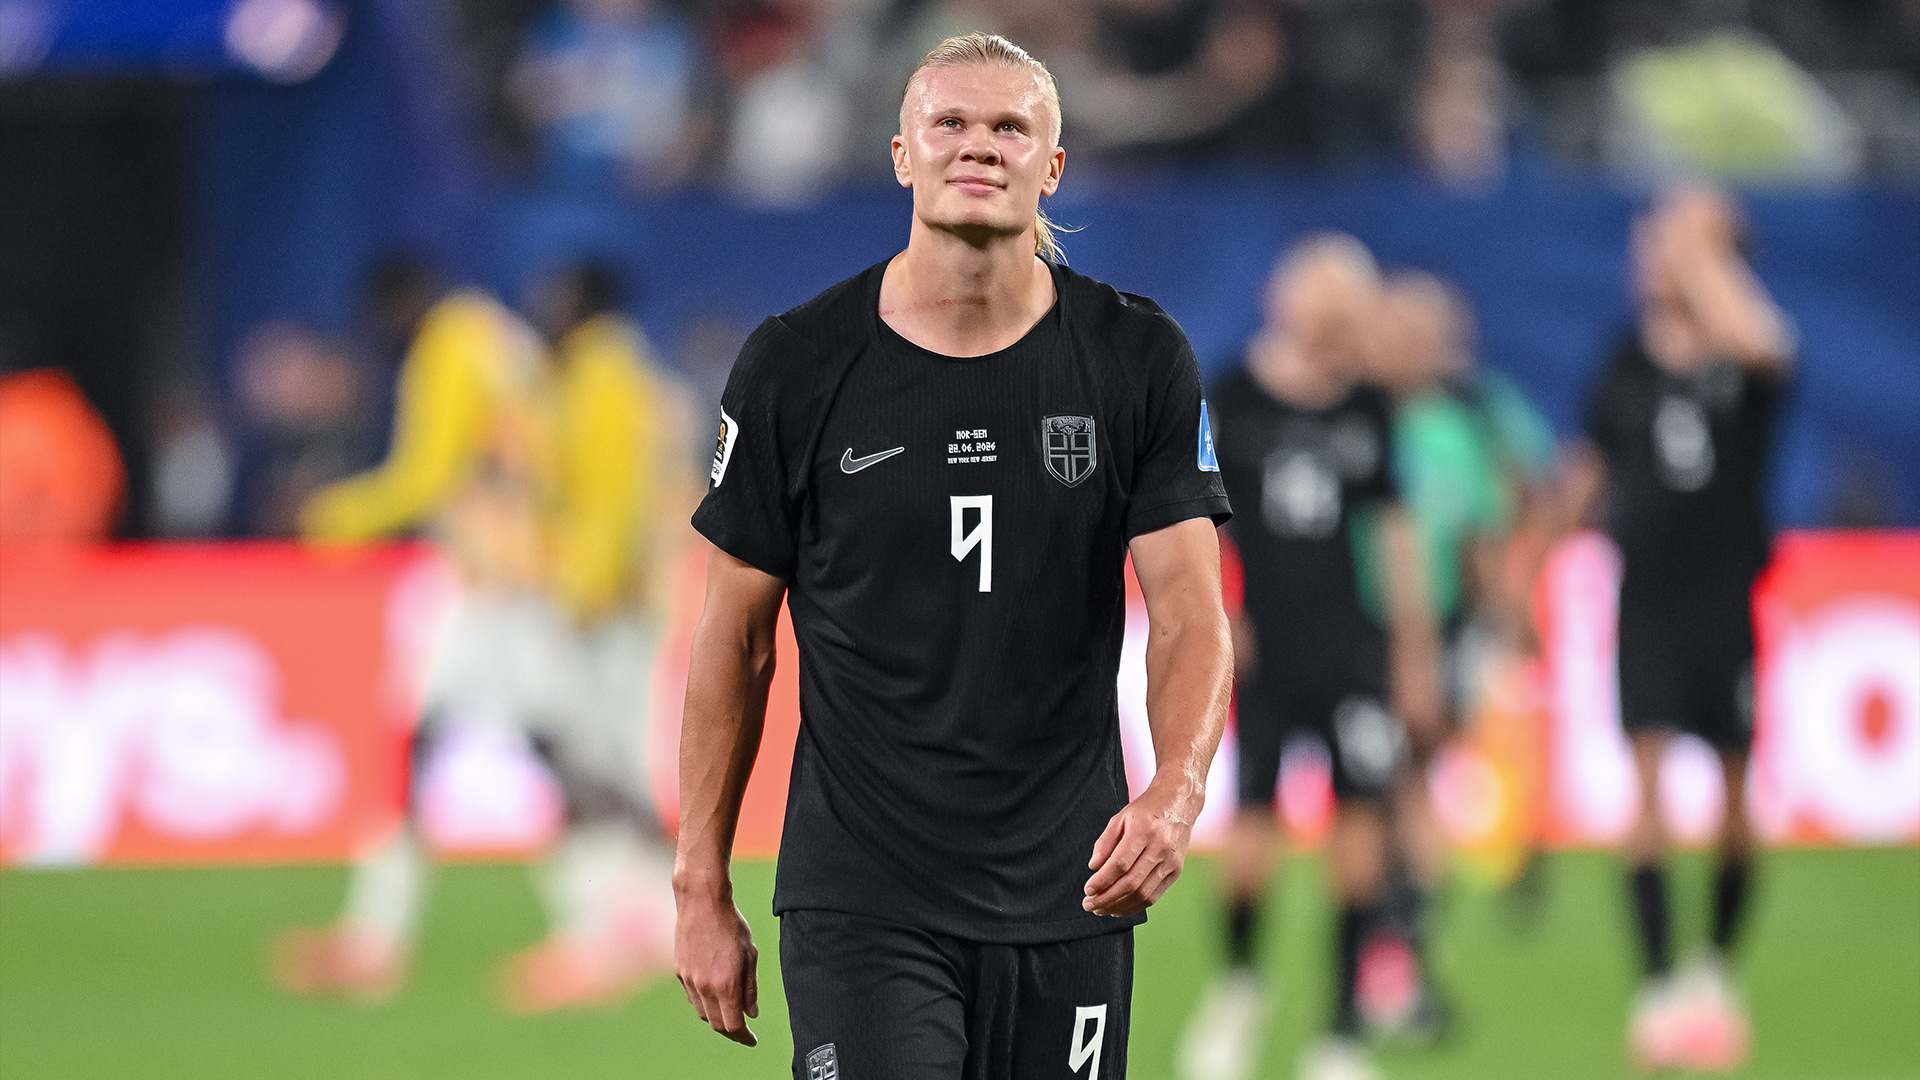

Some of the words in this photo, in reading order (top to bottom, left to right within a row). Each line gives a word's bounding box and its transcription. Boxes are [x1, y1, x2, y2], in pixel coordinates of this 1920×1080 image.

[956, 429, 988, 440] NOR-SEN
[958, 456, 970, 464] YORK
[981, 455, 998, 463] JERSEY
[950, 495, 993, 592] 9
[1068, 1003, 1107, 1080] 9
